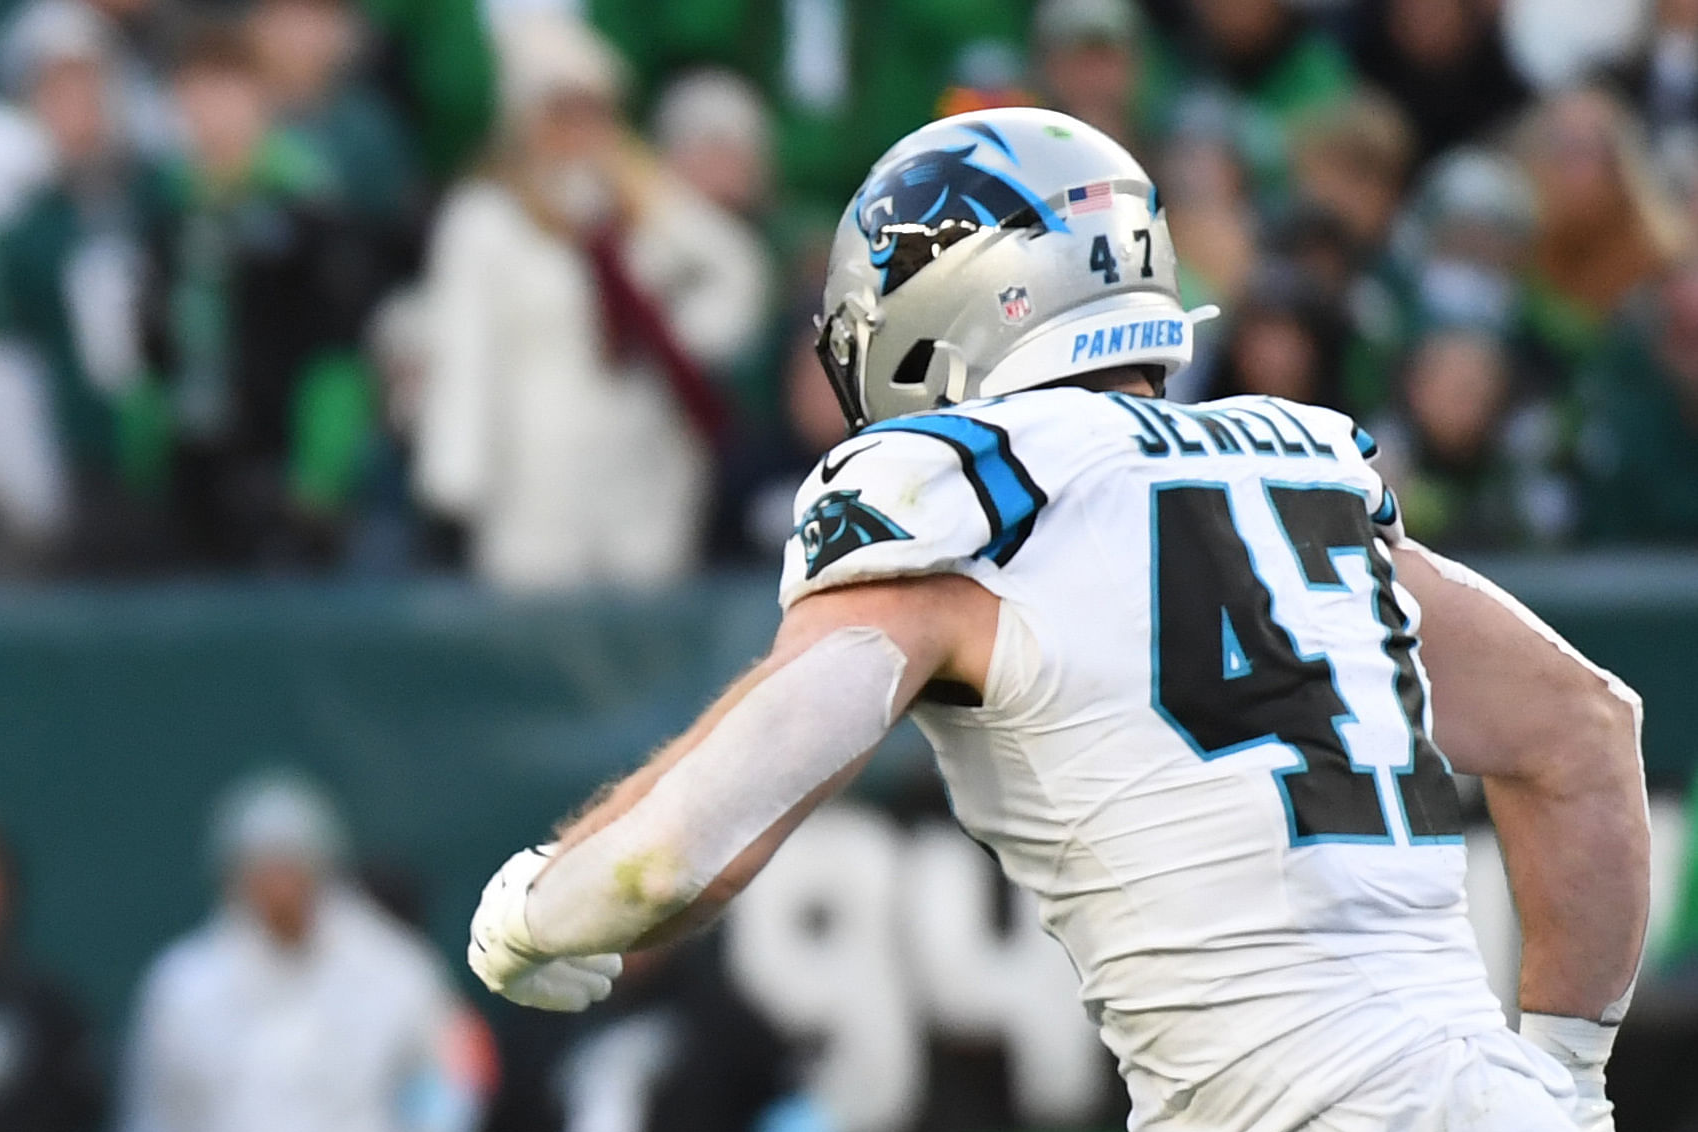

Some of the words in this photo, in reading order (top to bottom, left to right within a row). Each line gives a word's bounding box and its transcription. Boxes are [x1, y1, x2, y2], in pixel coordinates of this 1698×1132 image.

[1090, 229, 1153, 284] 47
[1071, 319, 1183, 364] PANTHERS
[1103, 390, 1339, 459] JEWELL
[1150, 478, 1464, 846] 47
